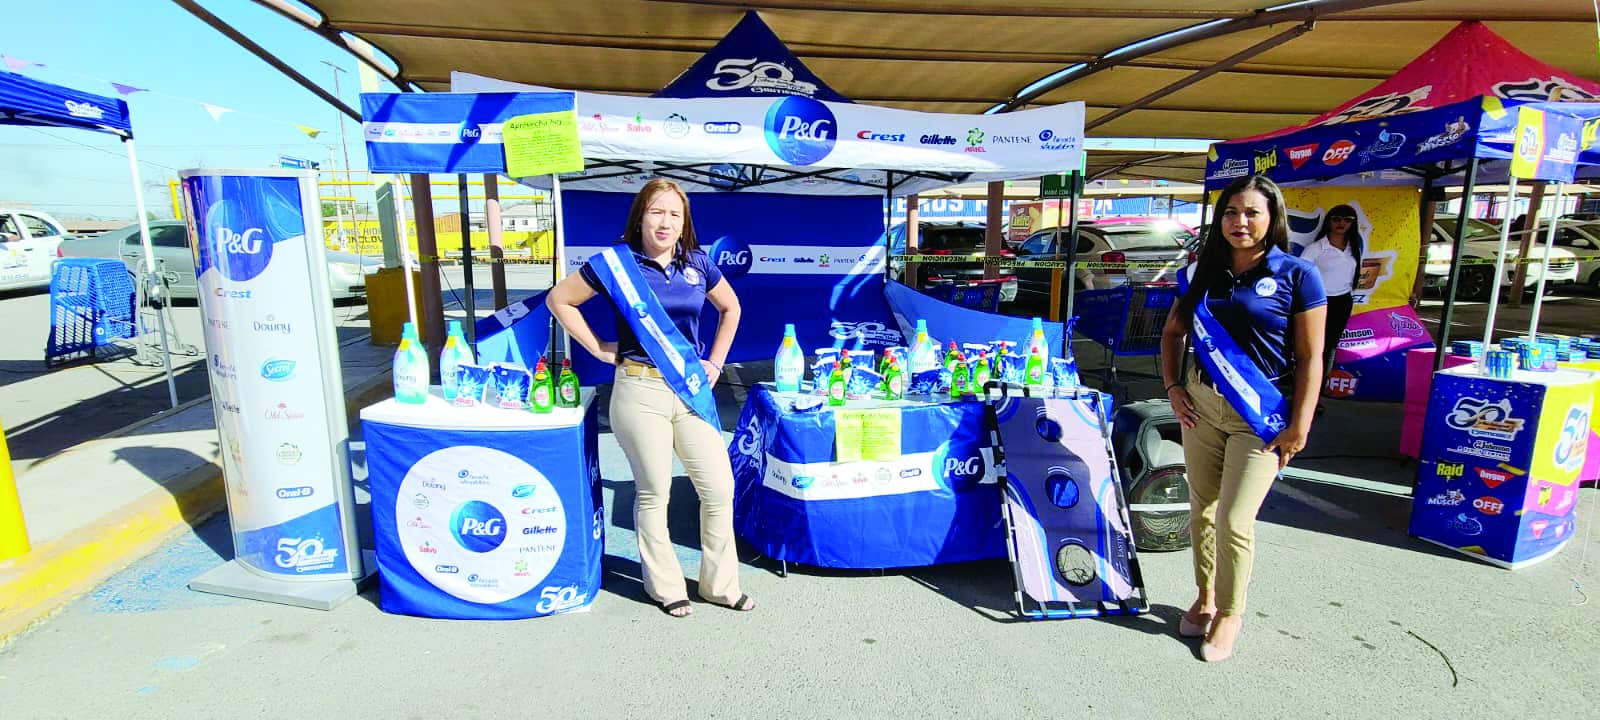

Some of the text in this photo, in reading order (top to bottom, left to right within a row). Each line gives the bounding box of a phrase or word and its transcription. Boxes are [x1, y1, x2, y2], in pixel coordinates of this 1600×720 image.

[706, 58, 794, 91] 50
[462, 128, 479, 138] P&G
[627, 123, 651, 133] Salvo
[779, 115, 831, 141] P&G
[857, 130, 906, 142] Crest
[919, 134, 957, 146] Gillette
[1322, 145, 1356, 161] OFF!
[1254, 151, 1277, 173] Raid
[216, 227, 263, 255] P&G
[717, 250, 749, 266] P&G
[922, 255, 967, 263] PRECAUCION
[214, 287, 252, 298] Crest
[253, 320, 291, 334] Downy
[266, 362, 290, 378] Secret
[1326, 377, 1357, 394] FF!
[1448, 397, 1506, 428] 50
[944, 456, 980, 477] P&G
[1436, 463, 1464, 477] Raid
[521, 506, 558, 515] Crest
[1472, 498, 1504, 514] OFF!
[461, 518, 501, 536] P&G
[522, 525, 558, 535] Gillette
[275, 538, 324, 568] 50
[520, 545, 557, 554] PANTENE
[535, 585, 578, 614] 50
